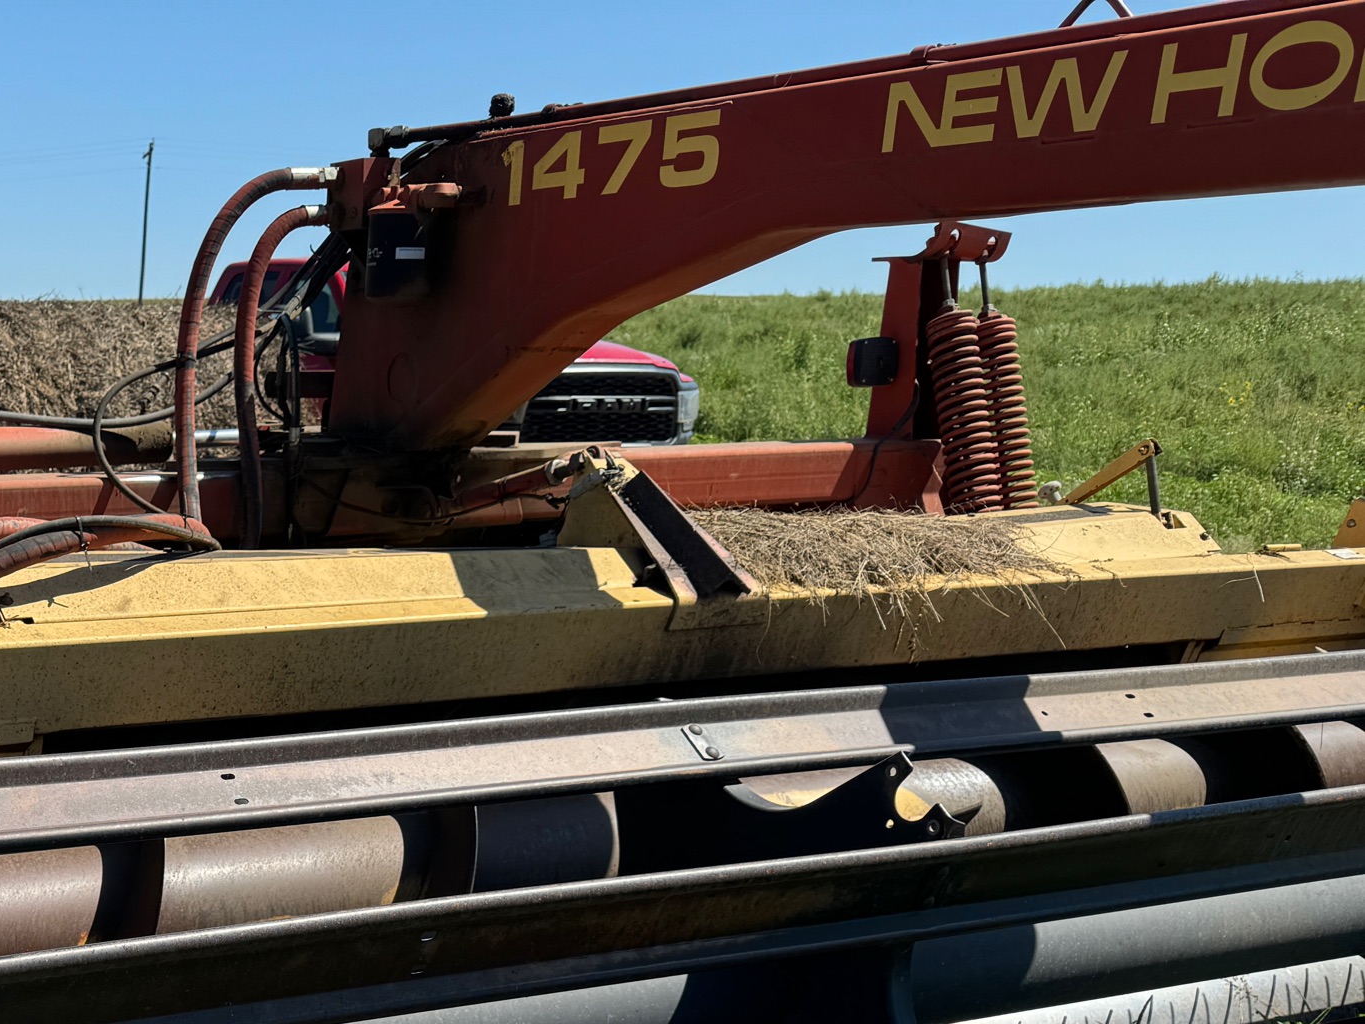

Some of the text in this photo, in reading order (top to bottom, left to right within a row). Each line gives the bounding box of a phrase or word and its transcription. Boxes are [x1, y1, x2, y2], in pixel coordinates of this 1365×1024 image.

[881, 20, 1365, 154] NEW HO
[501, 109, 722, 207] 1475
